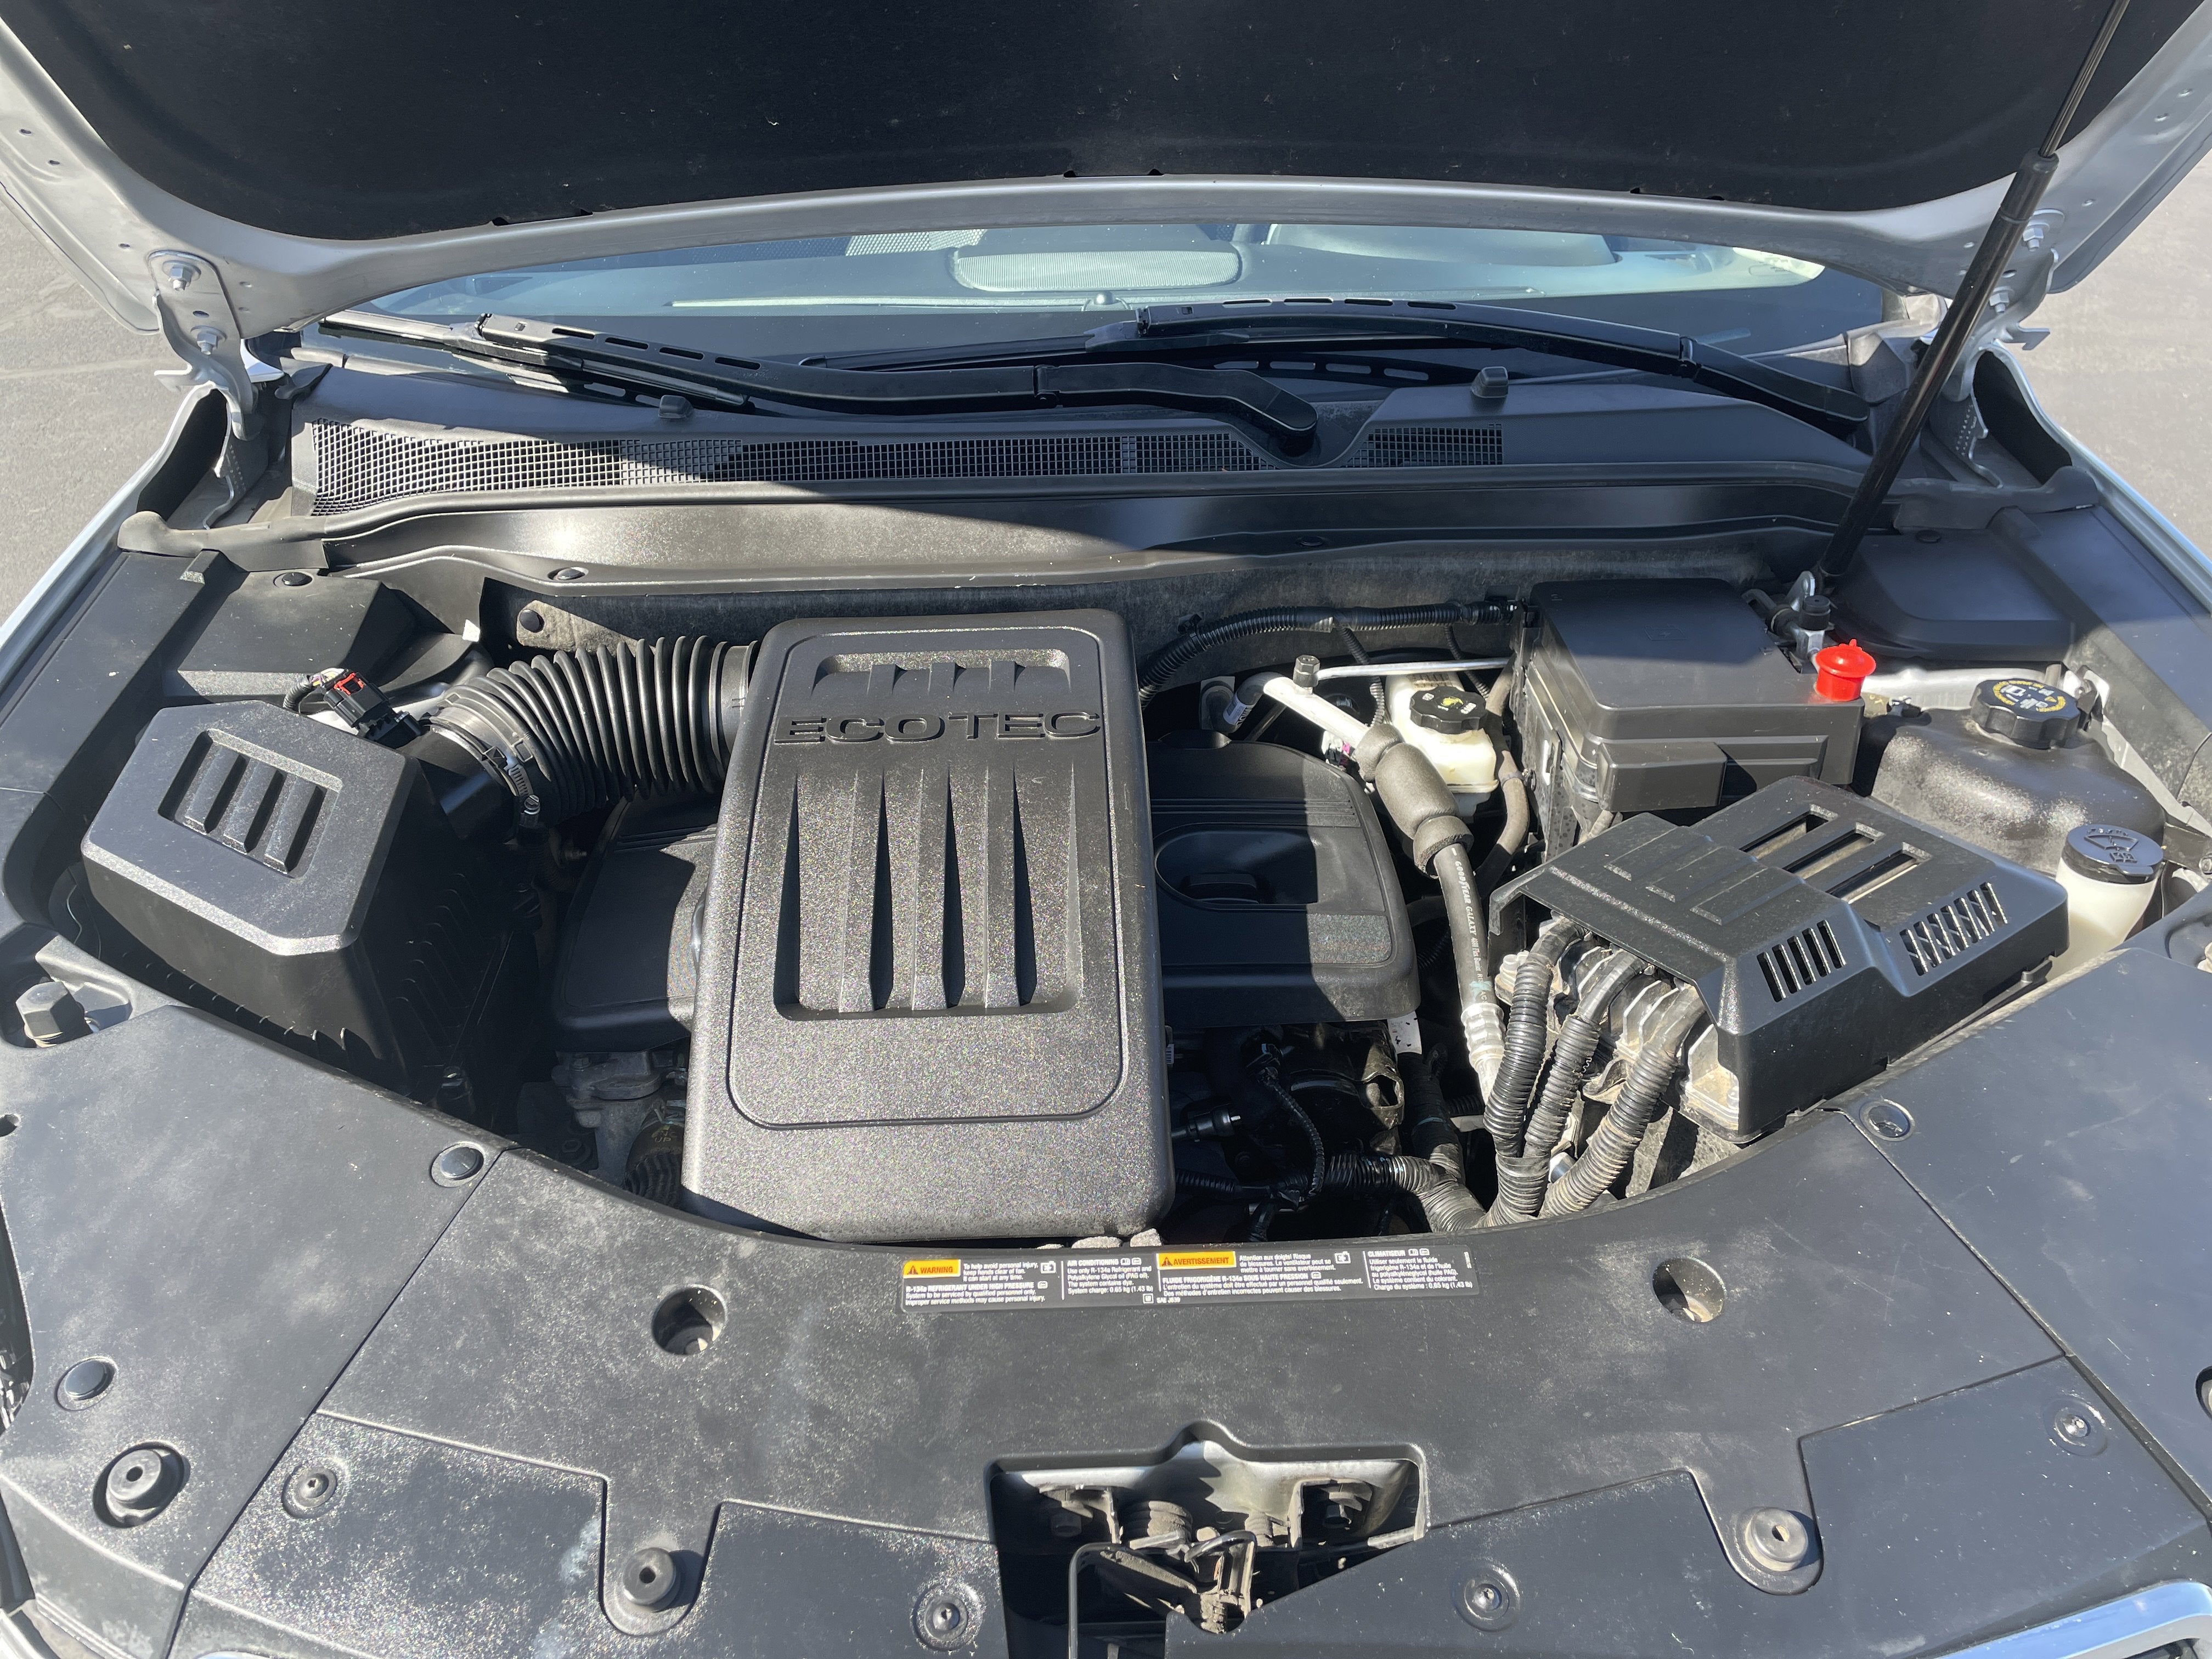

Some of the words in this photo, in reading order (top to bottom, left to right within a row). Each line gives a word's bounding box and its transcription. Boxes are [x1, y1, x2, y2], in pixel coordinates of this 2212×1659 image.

[774, 711, 1101, 744] ECOTEC
[1455, 860, 1471, 904] GOODYEAR
[1465, 906, 1477, 935] GALAXY
[1078, 1259, 1119, 1267] CONDITIONING
[1173, 1257, 1229, 1265] AVERTISSEMENT
[1286, 1279, 1313, 1288] personnel
[1068, 1288, 1088, 1296] System
[1262, 1287, 1284, 1295] peuvent
[1005, 1295, 1029, 1304] personal
